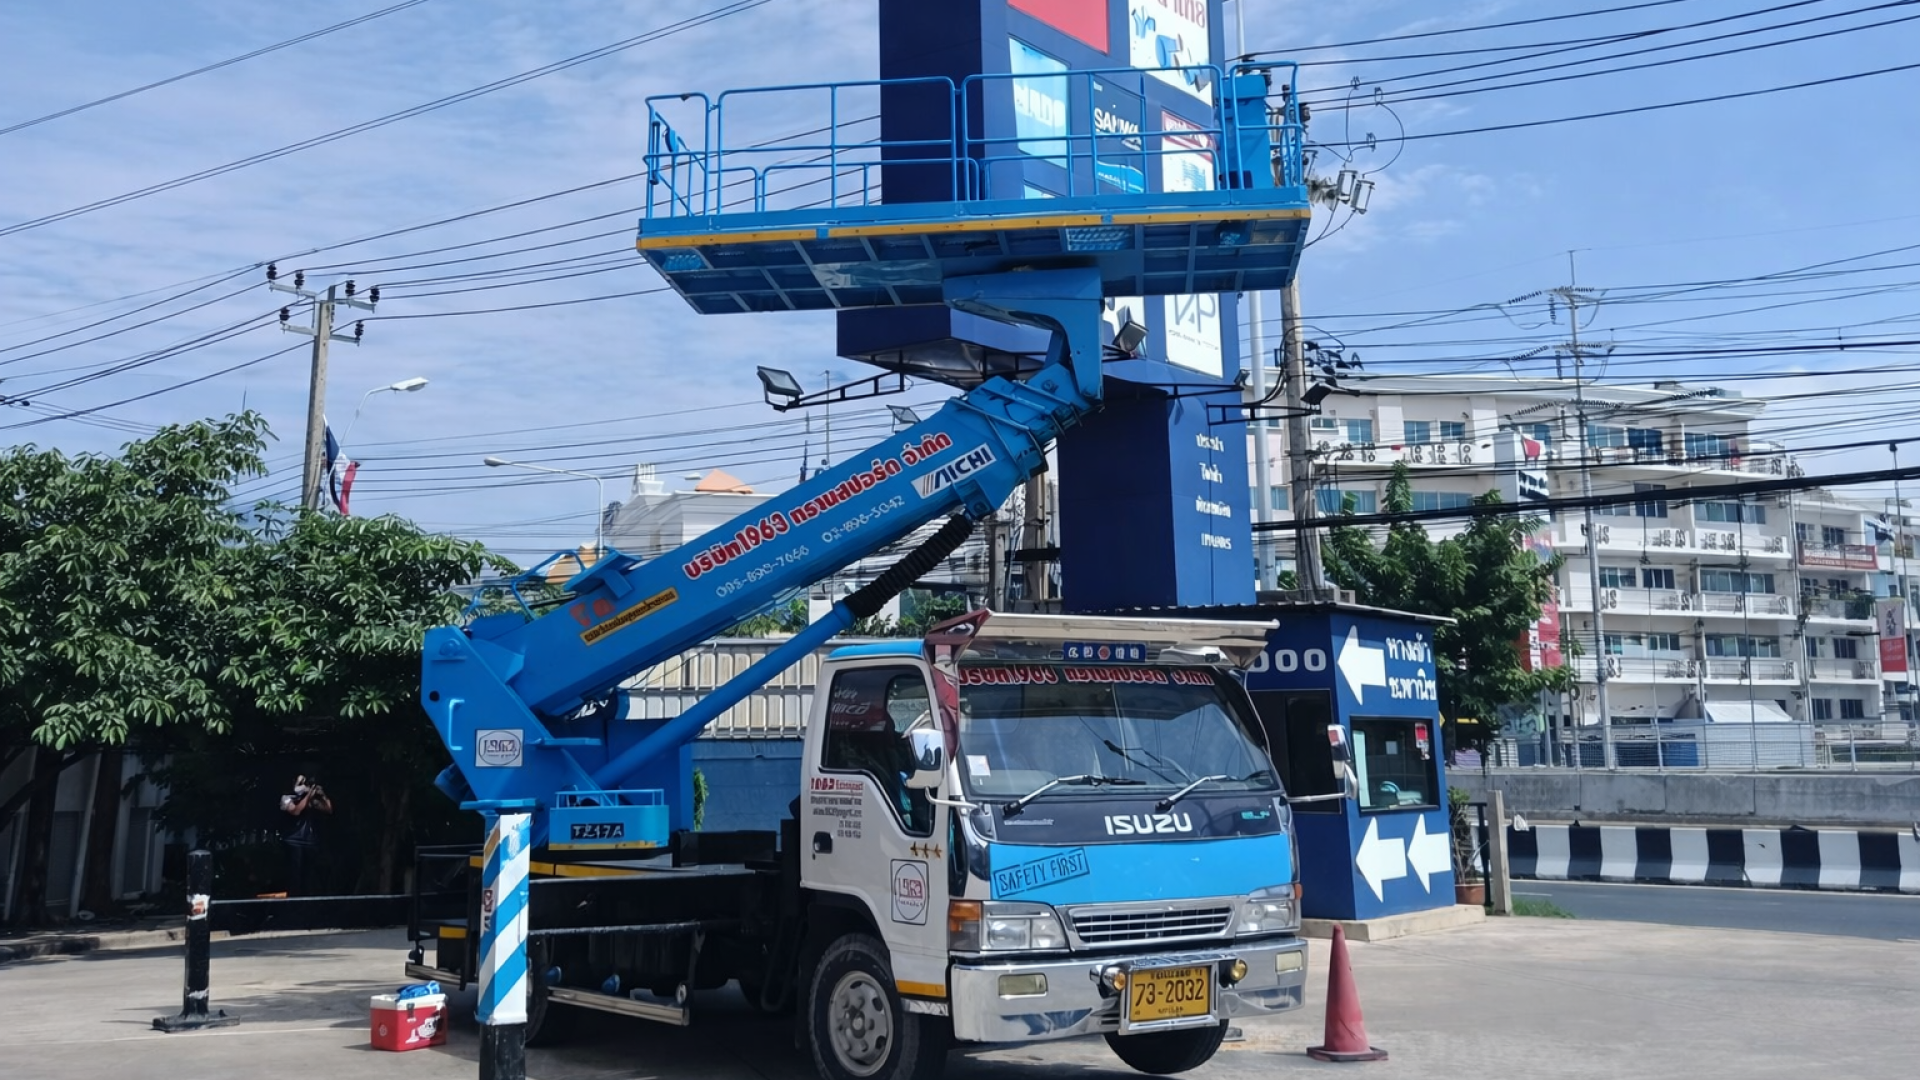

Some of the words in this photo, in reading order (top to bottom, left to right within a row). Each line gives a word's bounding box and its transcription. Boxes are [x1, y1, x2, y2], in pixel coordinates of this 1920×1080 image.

[900, 433, 953, 467] จำกัด
[931, 446, 994, 490] AICHI
[1386, 632, 1432, 663] ทางเข้า
[1104, 812, 1193, 835] ISUZU
[1000, 866, 1046, 892] SAFETY
[1051, 853, 1085, 877] FIRST
[1135, 978, 1205, 1007] 73-2032
